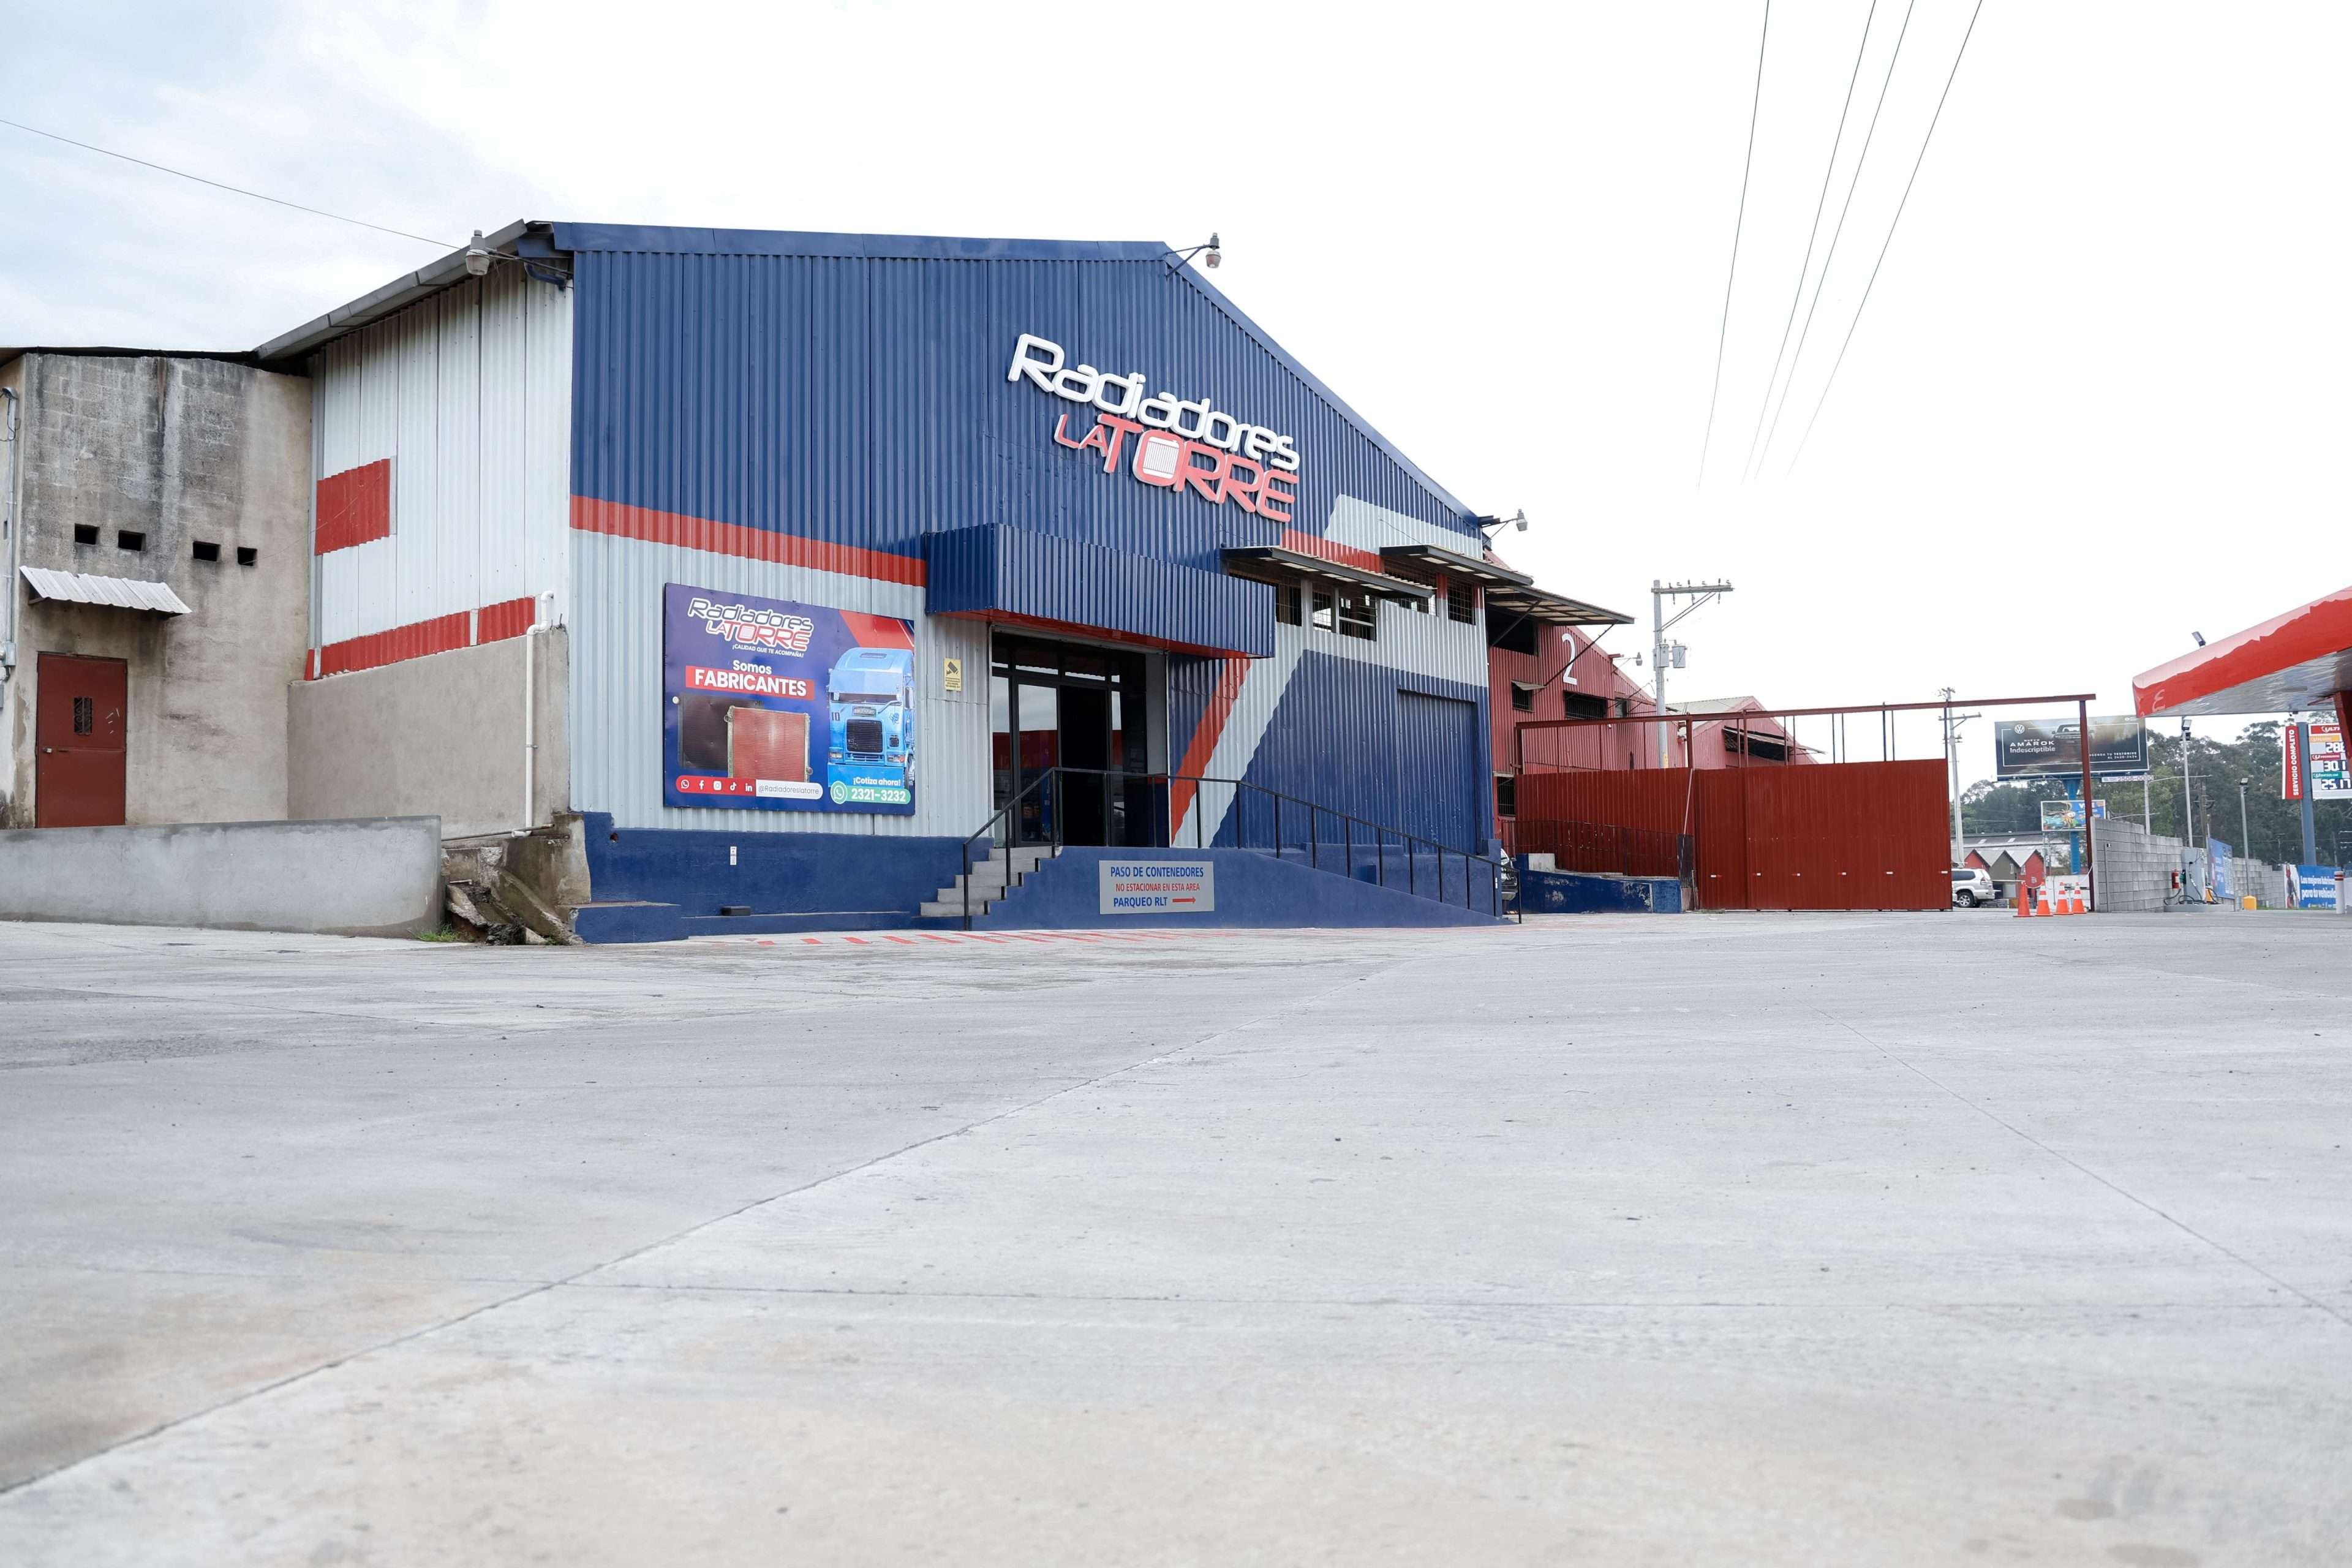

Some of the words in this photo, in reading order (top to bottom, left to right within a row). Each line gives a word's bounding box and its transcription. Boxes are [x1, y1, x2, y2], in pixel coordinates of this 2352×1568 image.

[1008, 333, 1300, 471] Radiadores
[1054, 413, 1109, 458] LA
[1097, 413, 1299, 522] TORRE
[688, 598, 813, 631] Radiadores
[706, 620, 727, 635] LA
[724, 620, 812, 651] TORRE
[1562, 633, 1577, 685] 2
[733, 660, 772, 674] Somos
[695, 669, 807, 696] FABRICANTES
[853, 776, 877, 785] ¡Cotiza
[758, 785, 820, 795] @Radiadoreslatorre
[851, 788, 906, 802] 2321-3232
[1110, 867, 1131, 877] PASO
[1133, 867, 1144, 877] DE
[1145, 867, 1204, 878] CONTENEDORES
[1116, 883, 1125, 892] NO
[1126, 883, 1161, 892] ESTACIONAR
[1114, 897, 1152, 908] PARQUEO
[1155, 897, 1168, 906] RLT
